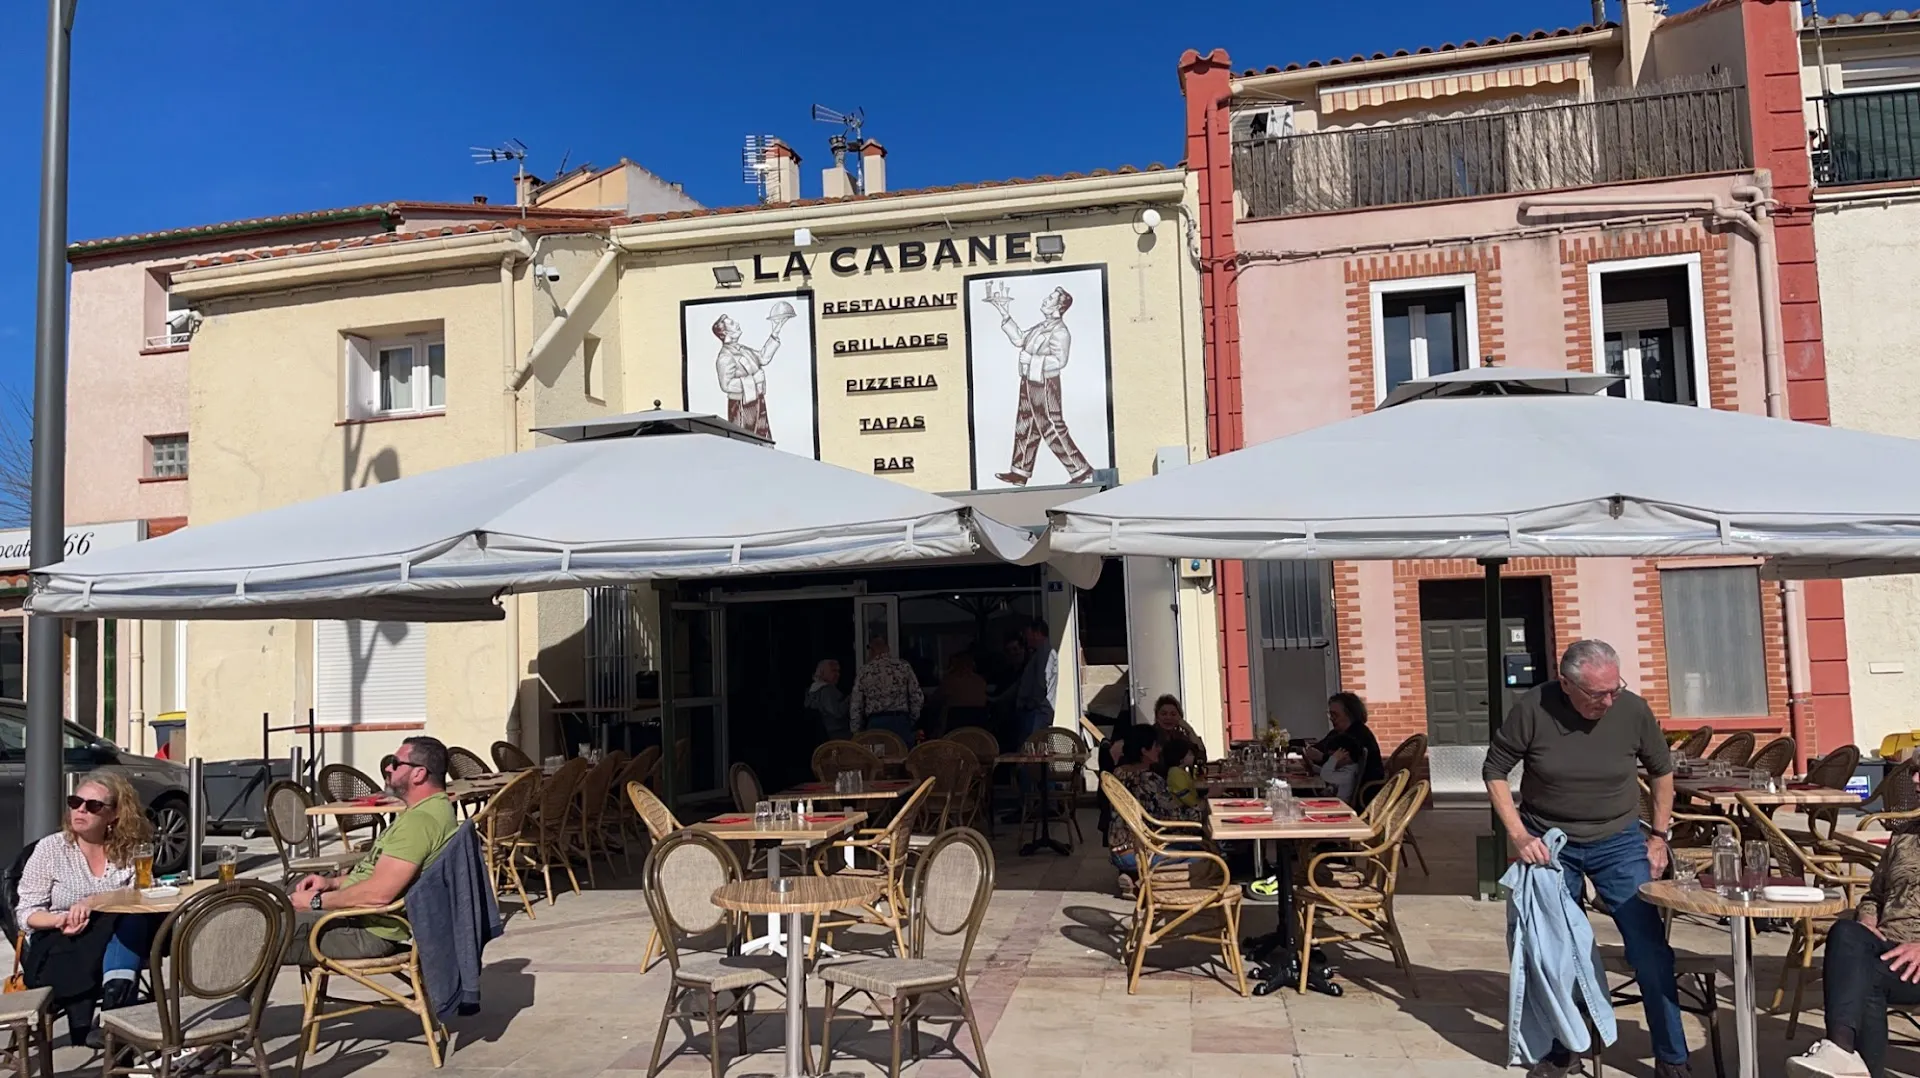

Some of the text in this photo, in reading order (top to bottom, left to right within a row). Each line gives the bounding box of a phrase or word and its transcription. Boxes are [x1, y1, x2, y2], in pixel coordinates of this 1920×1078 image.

[753, 231, 1032, 281] LA CABANE
[822, 292, 958, 315] RESTAURANT
[833, 333, 948, 354] GRILLADES
[846, 374, 938, 393] PIZZERIA
[859, 415, 926, 432] TAPAS
[873, 456, 915, 471] BAR
[0, 538, 31, 559] ocat
